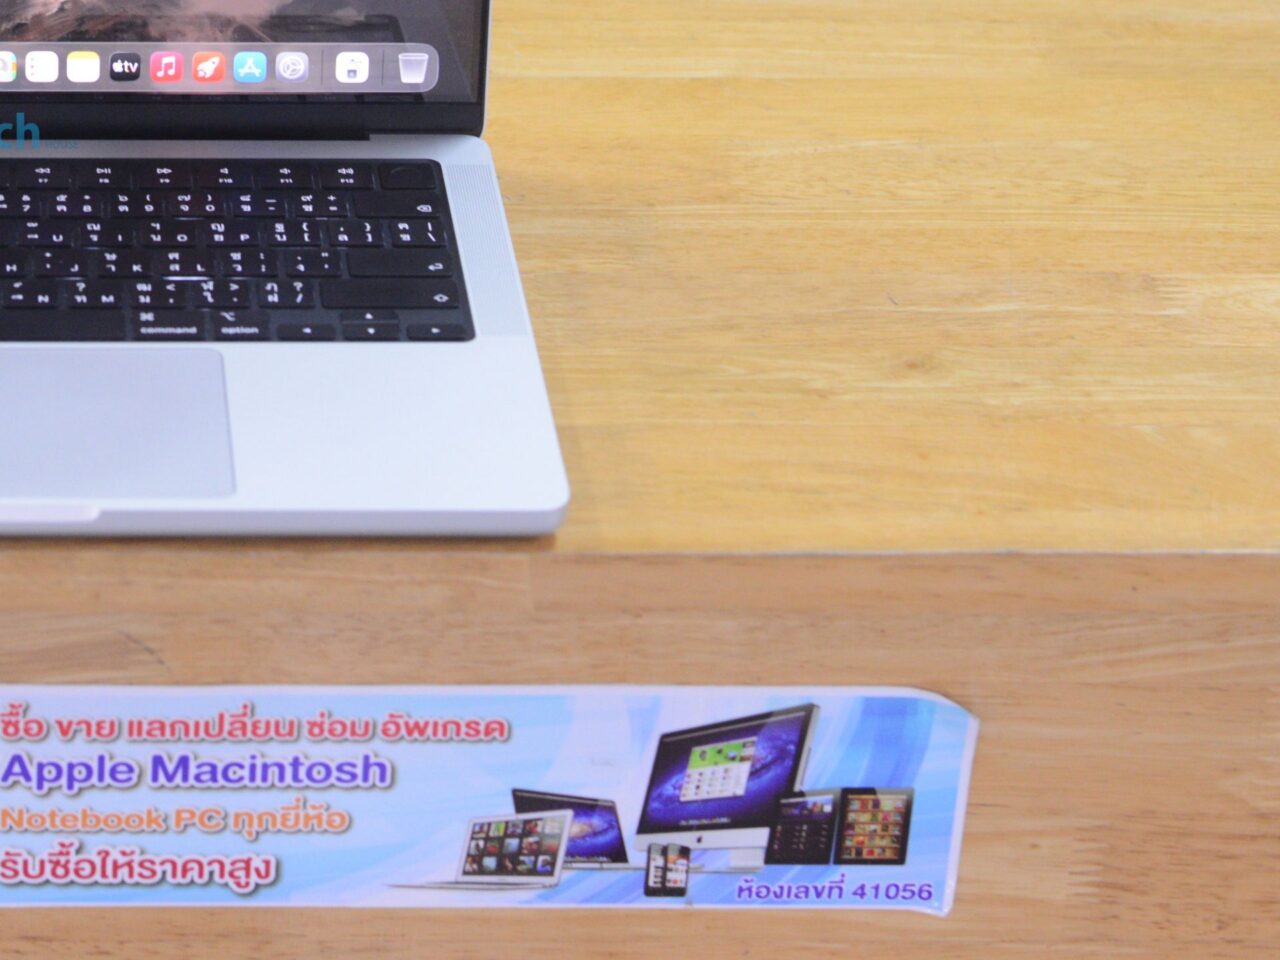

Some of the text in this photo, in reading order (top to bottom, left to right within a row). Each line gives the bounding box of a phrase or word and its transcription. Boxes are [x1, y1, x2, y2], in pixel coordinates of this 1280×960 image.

[139, 326, 198, 335] command
[220, 326, 260, 335] option
[0, 703, 45, 738] ซื้อ
[55, 718, 116, 738] ขาย
[127, 704, 296, 738] แลกเปลี่ยน
[306, 711, 370, 738] ซ่อม
[0, 753, 388, 791] Apple Macintosh
[0, 797, 349, 838] Notebook PC ทุกยี่ห้อ
[851, 882, 934, 901] 41056
